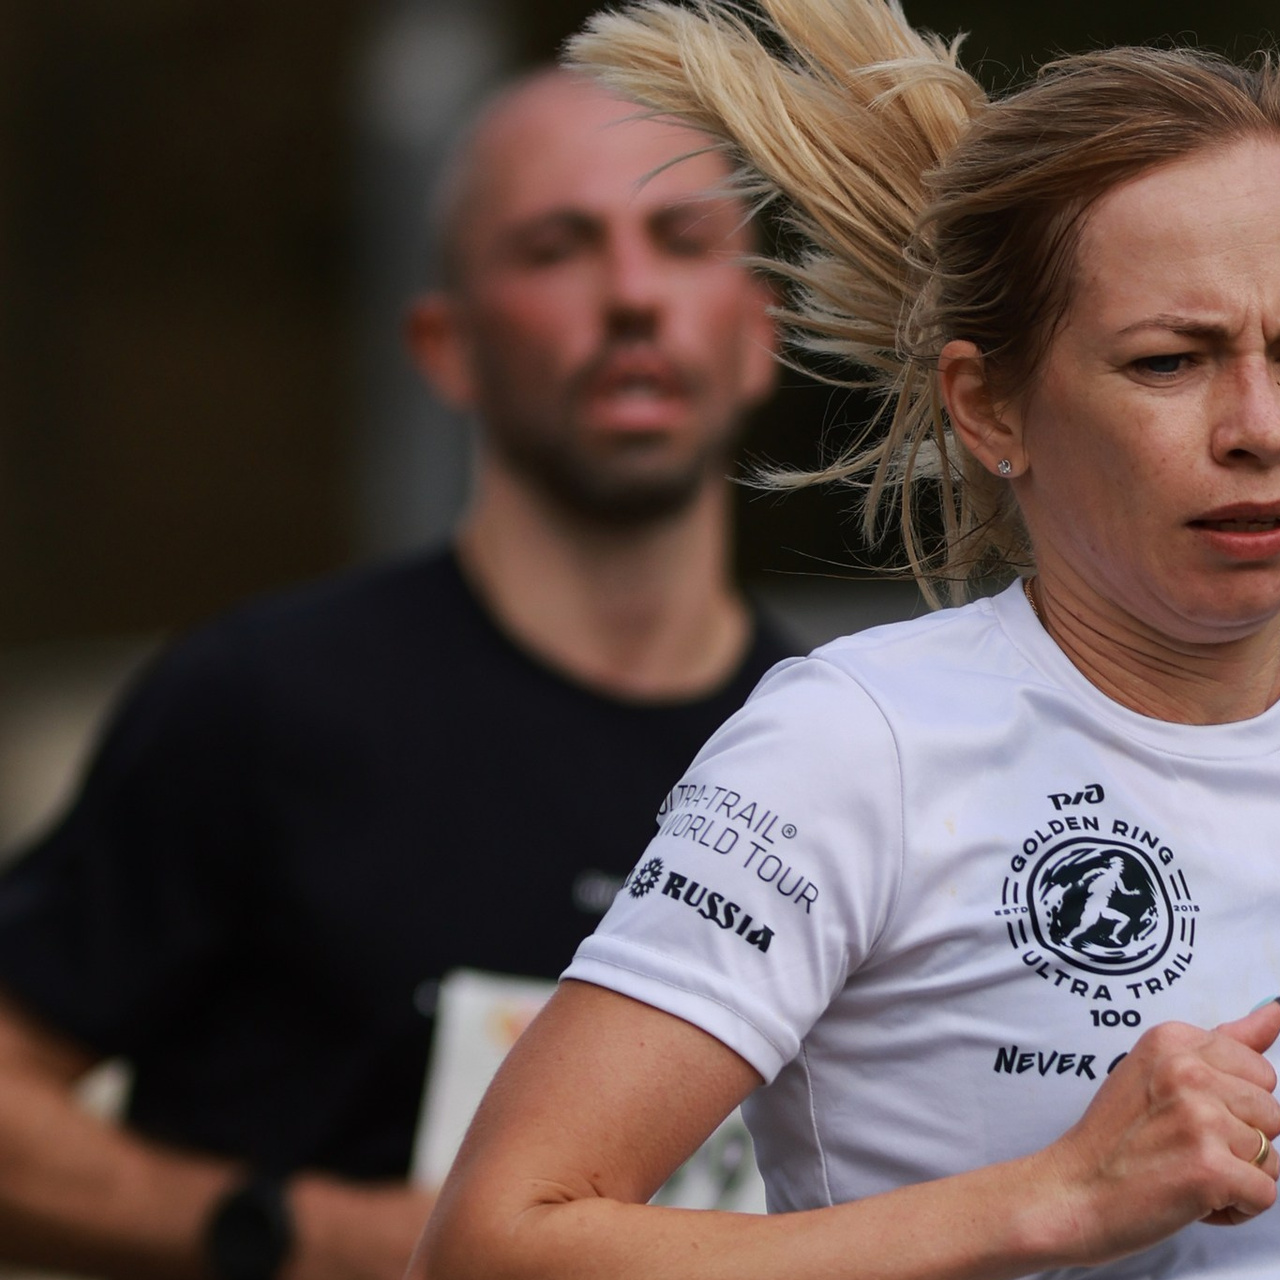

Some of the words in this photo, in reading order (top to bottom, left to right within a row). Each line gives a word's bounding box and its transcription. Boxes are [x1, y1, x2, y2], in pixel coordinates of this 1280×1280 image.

[660, 813, 739, 855] WORLD
[743, 841, 819, 914] TOUR
[1010, 816, 1100, 873] GOLDEN
[1111, 819, 1174, 866] RING
[661, 870, 775, 953] RUSSIA
[994, 906, 1029, 917] ESTD
[1173, 904, 1201, 913] 2015
[1022, 950, 1112, 1001] ULTRA
[1126, 952, 1193, 1000] TRAIL
[1090, 1009, 1142, 1027] 100
[993, 1045, 1097, 1080] NEVER
